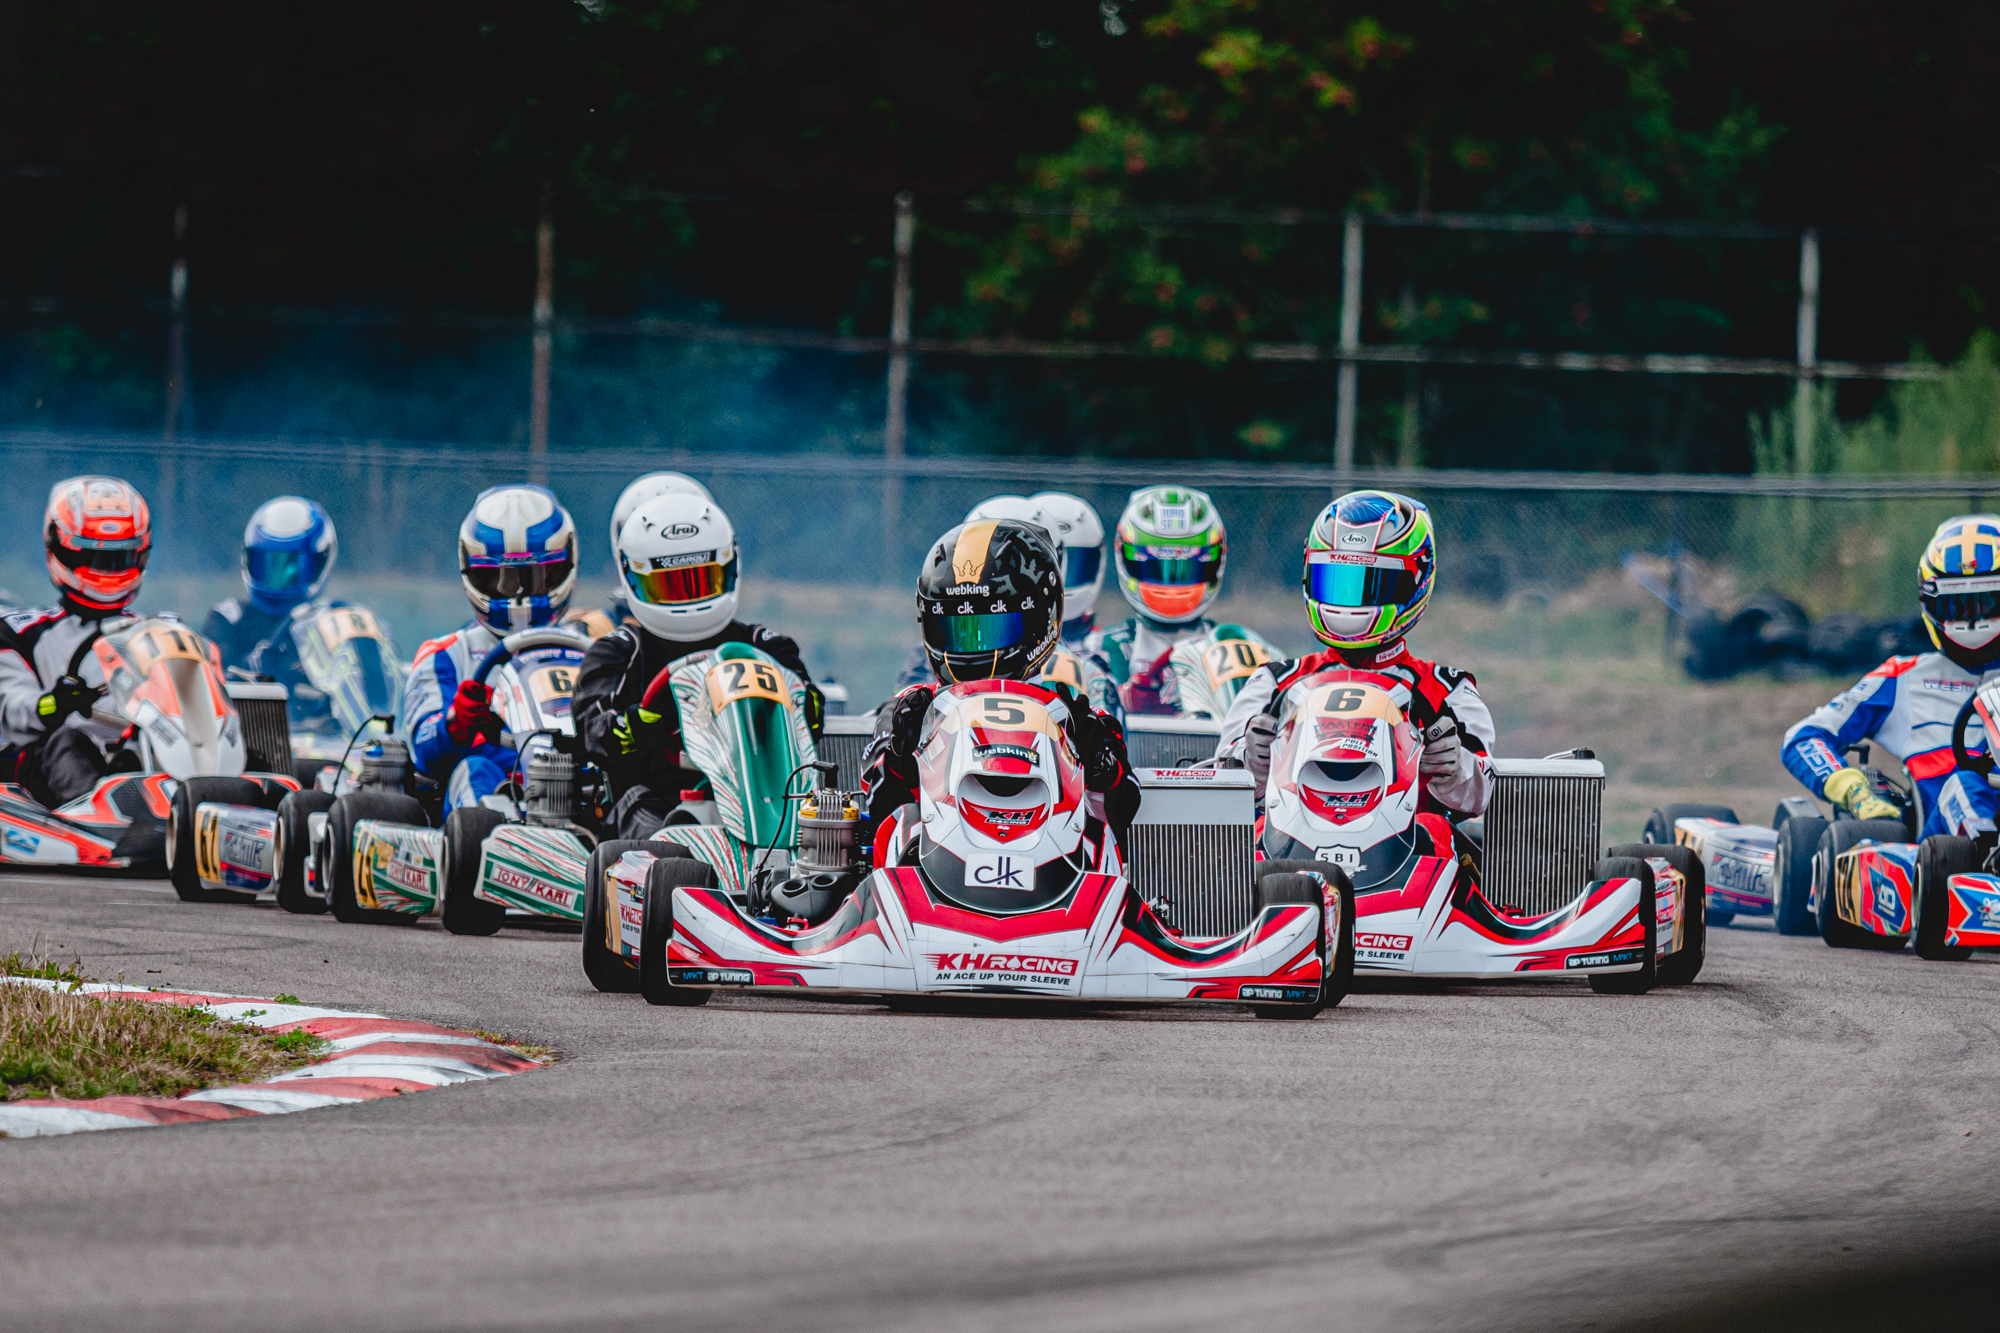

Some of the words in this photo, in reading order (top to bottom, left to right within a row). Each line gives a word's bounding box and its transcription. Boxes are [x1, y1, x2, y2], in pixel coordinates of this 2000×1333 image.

[664, 525, 695, 536] Arai
[1347, 534, 1364, 543] Arai
[946, 584, 990, 597] webking
[957, 602, 975, 614] clk
[990, 600, 1008, 613] clk
[1021, 596, 1035, 610] clk
[723, 662, 778, 694] 25
[1923, 678, 1975, 693] WEST
[1324, 688, 1366, 711] 6
[984, 698, 1025, 725] 5
[973, 748, 1038, 764] webking
[1328, 793, 1371, 803] KH
[988, 810, 1035, 821] KH
[974, 856, 1025, 888] clk
[535, 883, 570, 905] KART
[1367, 950, 1405, 960] SLEEVE
[936, 973, 951, 981] AN
[955, 972, 976, 980] ACE
[999, 973, 1027, 982] YOUR
[1030, 975, 1070, 986] SLEEVE
